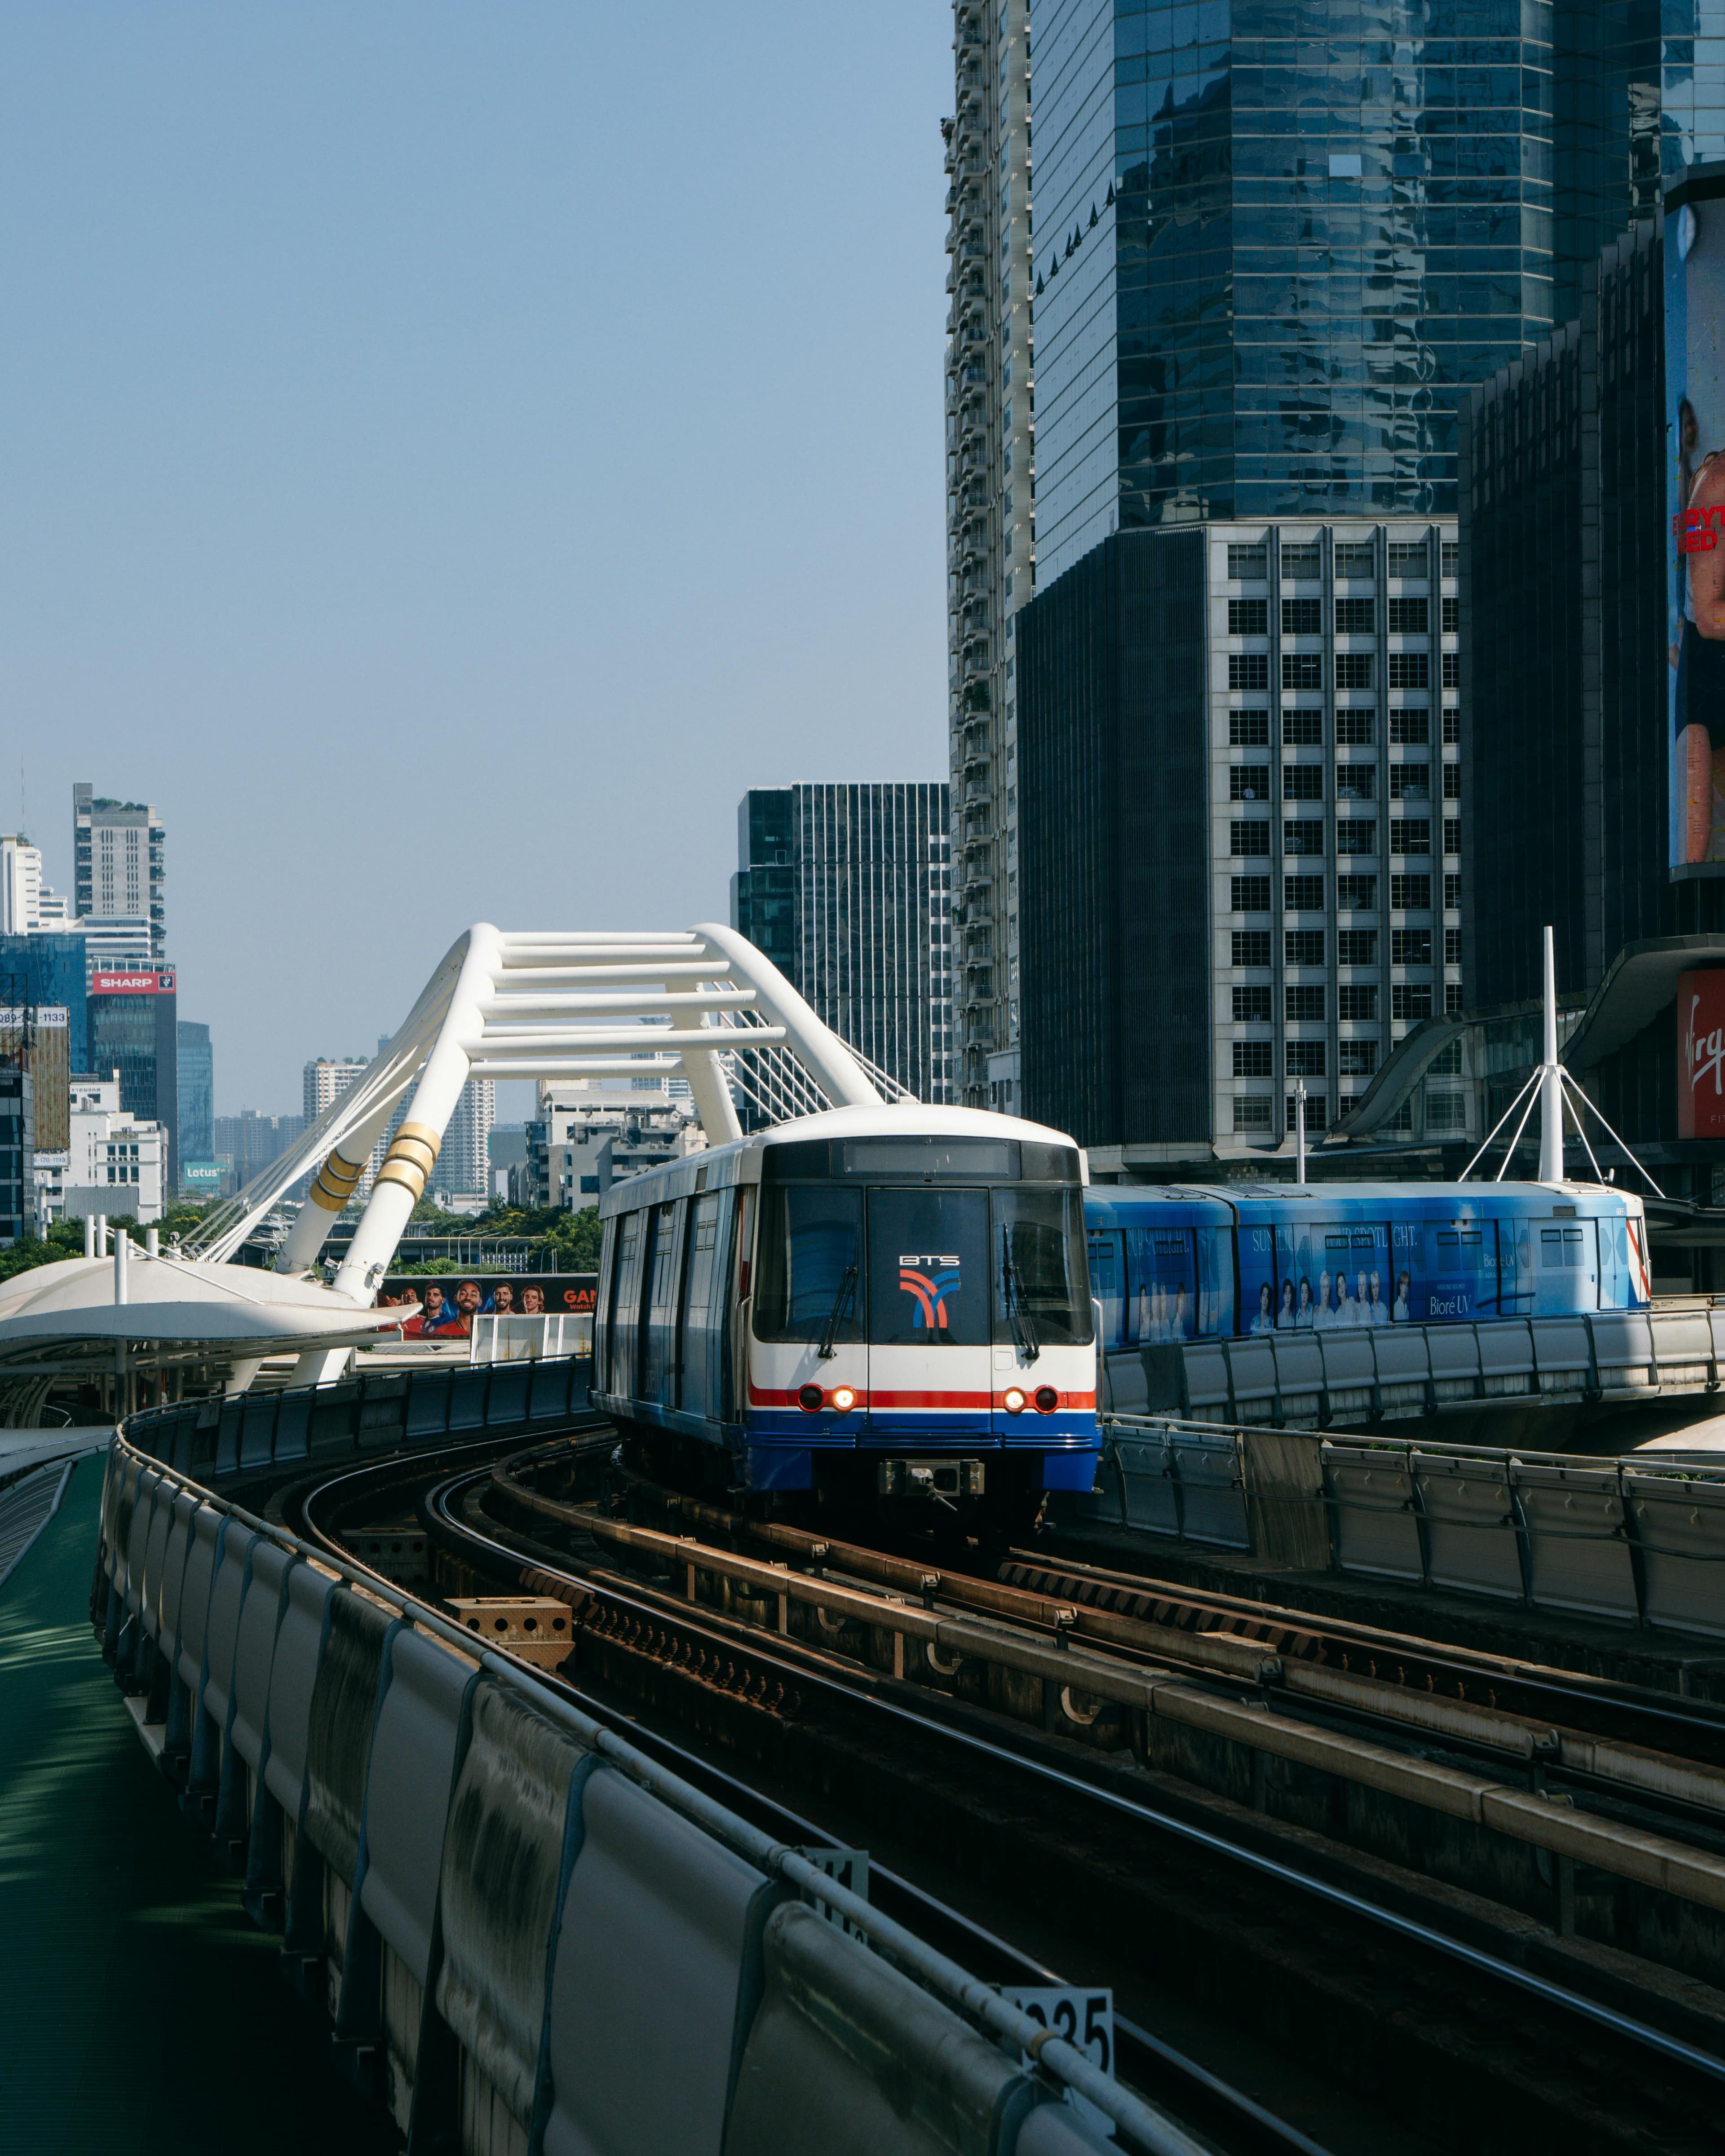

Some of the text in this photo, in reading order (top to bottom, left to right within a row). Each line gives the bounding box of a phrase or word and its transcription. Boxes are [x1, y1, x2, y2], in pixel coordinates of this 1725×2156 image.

[100, 978, 152, 987] SHARP
[1685, 994, 1725, 1095] Virg
[1354, 1225, 1418, 1248] SPOTLGHT.
[899, 1255, 960, 1266] BTS
[1430, 1295, 1472, 1315] Bioré UV
